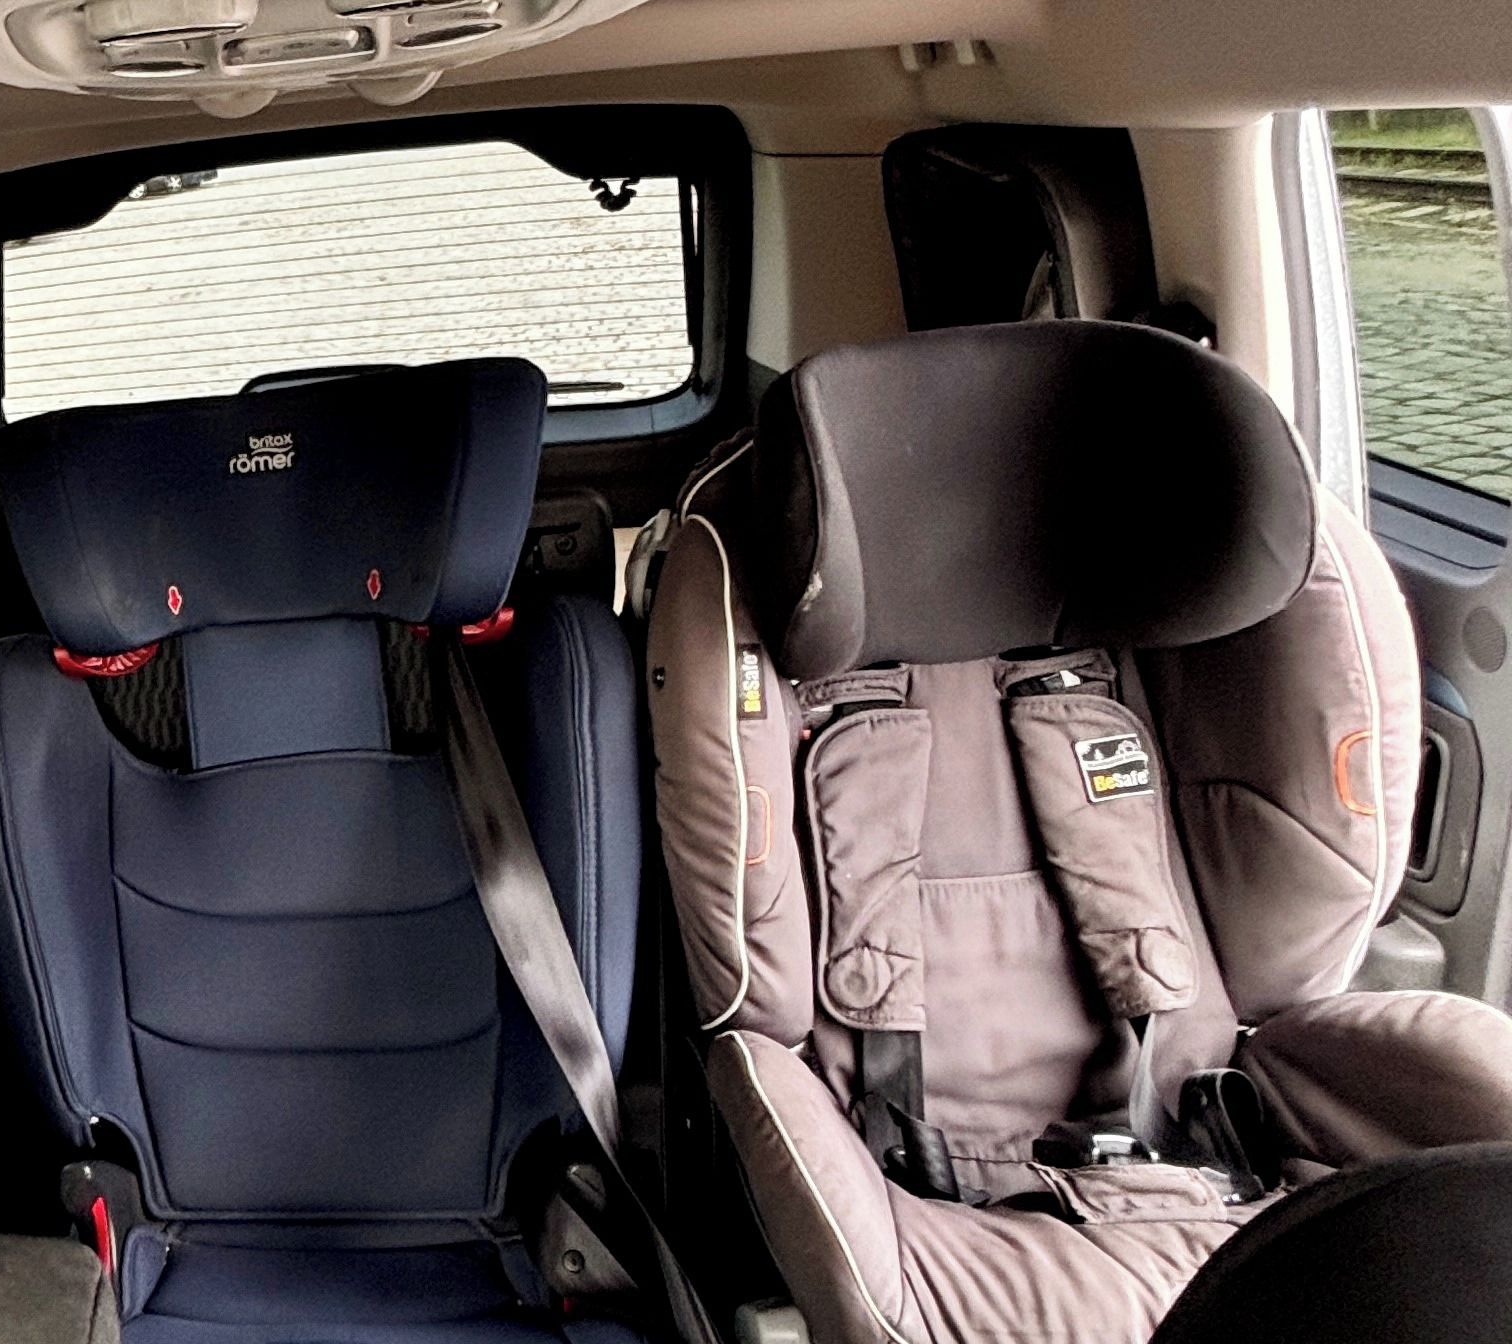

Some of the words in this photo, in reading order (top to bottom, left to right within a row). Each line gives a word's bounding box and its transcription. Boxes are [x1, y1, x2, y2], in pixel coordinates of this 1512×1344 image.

[249, 433, 293, 449] britax
[229, 452, 295, 474] römer
[742, 653, 761, 713] BeSafe
[1093, 769, 1149, 792] BeSafe
